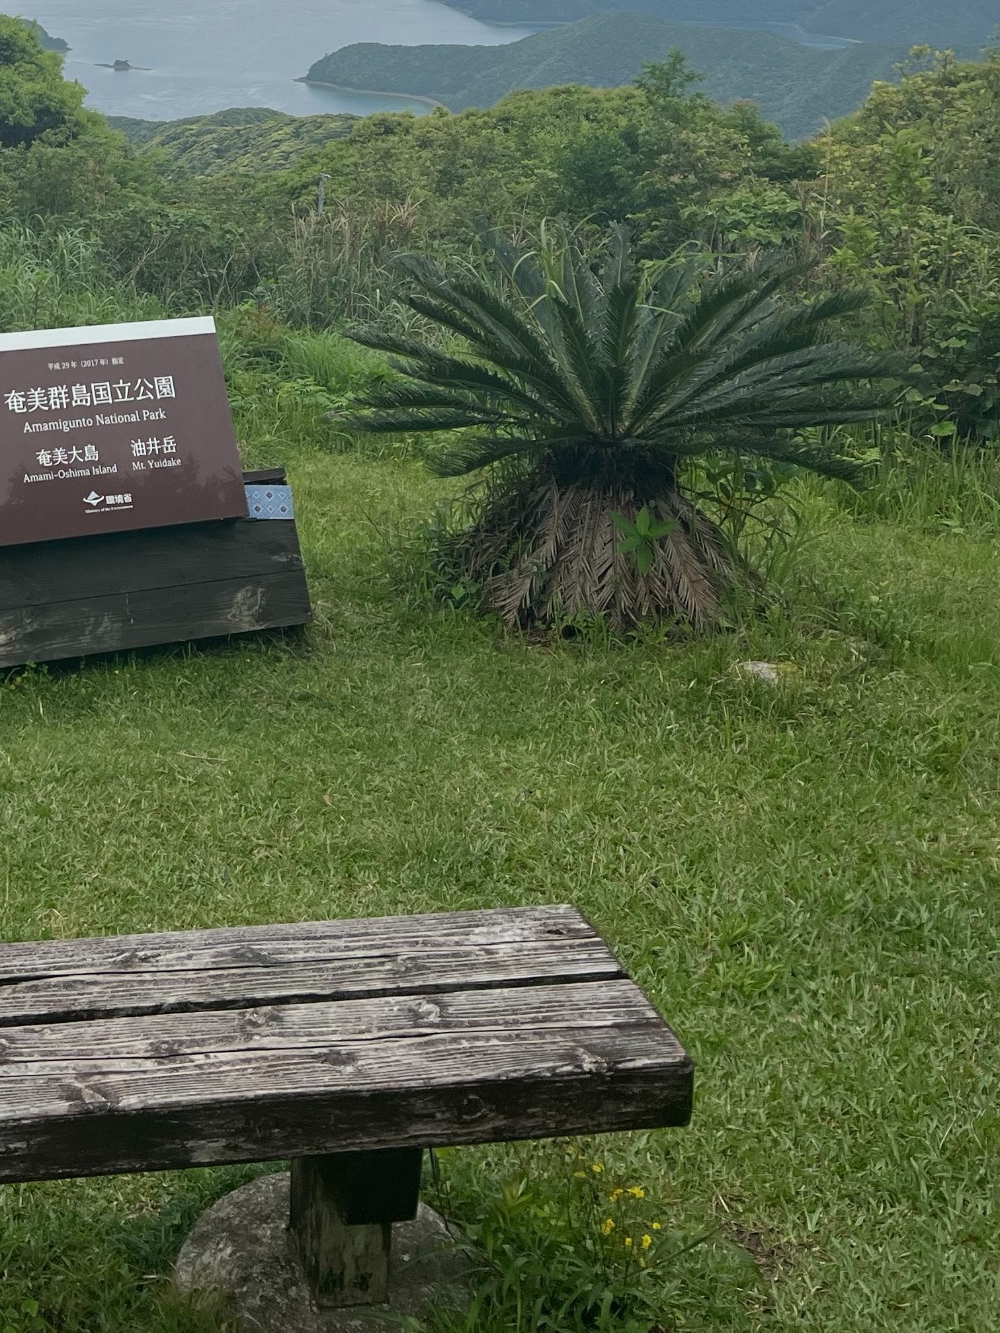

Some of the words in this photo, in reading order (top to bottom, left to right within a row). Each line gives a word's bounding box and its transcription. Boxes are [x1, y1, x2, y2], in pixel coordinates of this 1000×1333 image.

[3, 375, 176, 414] 奄美群島国立公園
[23, 417, 93, 433] Amamigunto
[95, 410, 140, 426] National
[142, 408, 167, 421] Park
[35, 444, 99, 467] 奄美大島
[130, 435, 177, 457] 油井岳
[23, 468, 90, 483] Amami-Oshima
[92, 464, 118, 475] Island
[132, 461, 146, 471] Mt.
[148, 457, 182, 469] Yuidake
